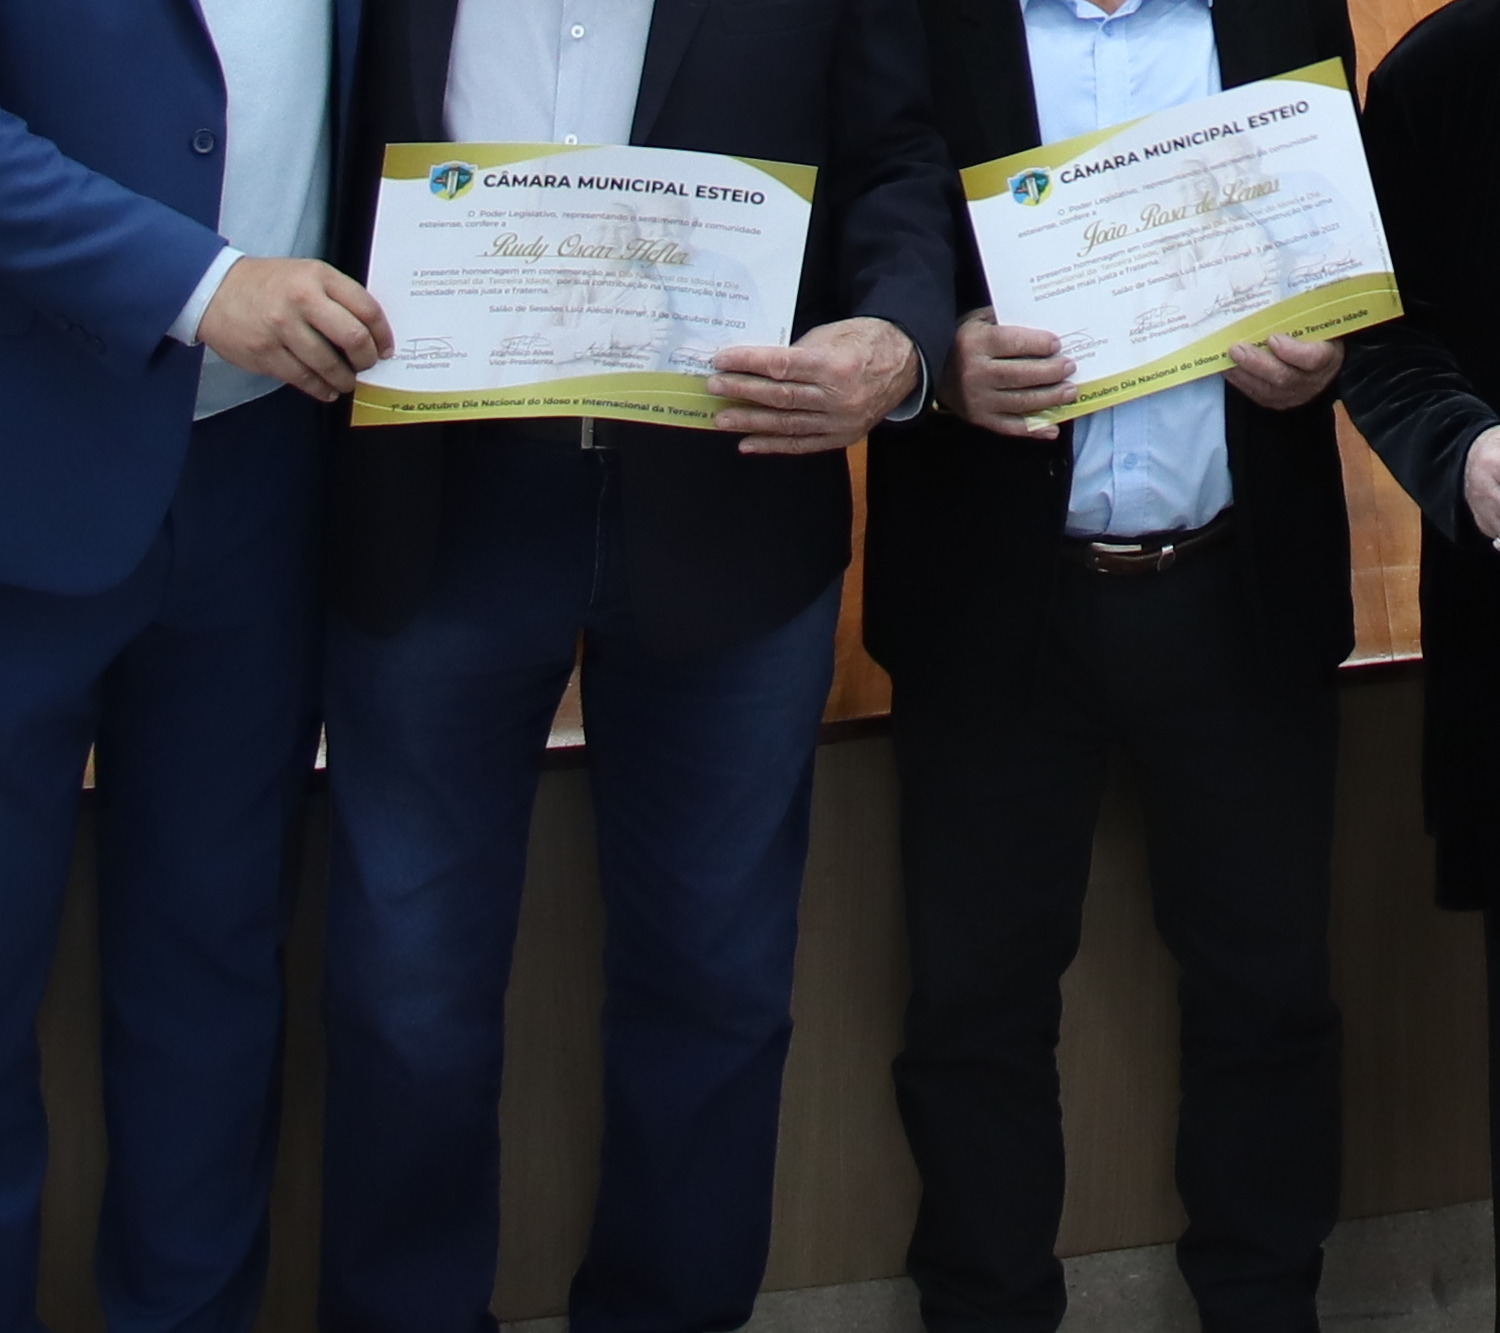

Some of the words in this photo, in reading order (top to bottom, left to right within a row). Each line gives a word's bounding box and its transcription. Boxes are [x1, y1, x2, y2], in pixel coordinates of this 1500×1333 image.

[1059, 151, 1141, 184] CÂMARA
[1143, 121, 1245, 160] MUNICIPAL
[1247, 100, 1310, 129] ESTEIO
[483, 171, 572, 188] CÂMARA
[577, 175, 689, 198] MUNICIPAL
[694, 185, 766, 205] ESTEIO
[484, 232, 550, 264] Rudy
[557, 233, 619, 259] Oscar
